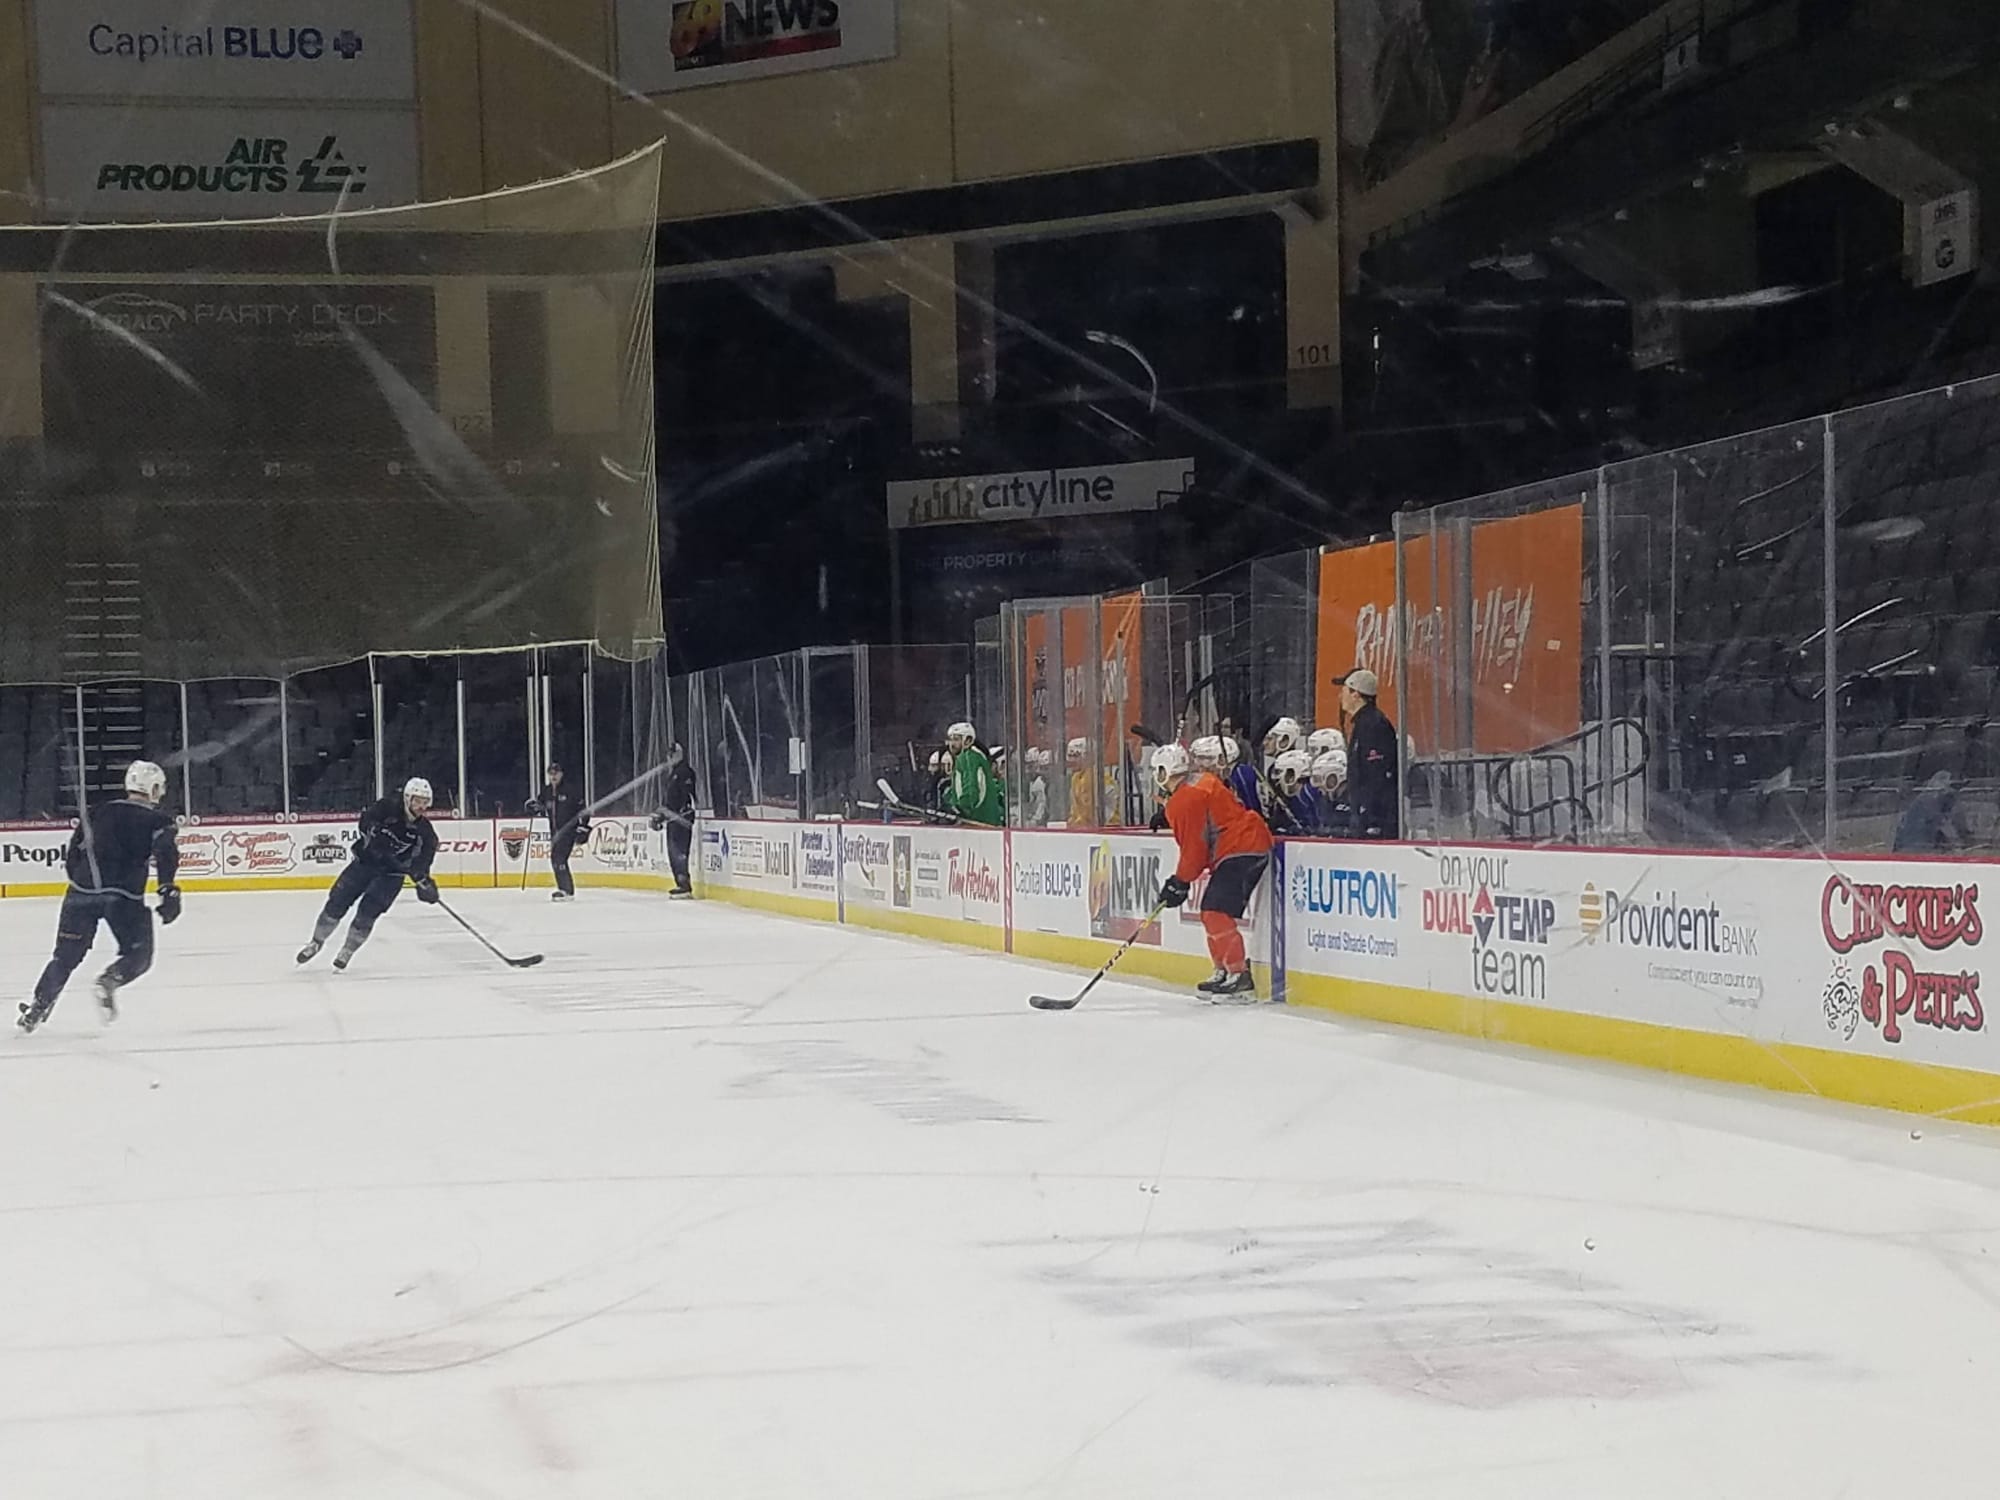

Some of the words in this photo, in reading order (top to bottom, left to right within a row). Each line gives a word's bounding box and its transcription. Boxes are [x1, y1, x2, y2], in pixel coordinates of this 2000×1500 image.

[724, 0, 839, 45] NEWS
[89, 24, 213, 62] Capital
[225, 138, 288, 164] AIR
[97, 164, 288, 192] PRODUCTS
[194, 303, 299, 325] PARTY
[312, 303, 397, 325] DECK
[1297, 344, 1330, 364] 101
[982, 470, 1114, 516] cityline
[943, 552, 1027, 571] PROPERTY
[303, 848, 347, 861] PLAYOFFS
[341, 830, 359, 842] PLA
[438, 840, 489, 853] CCM
[2, 844, 67, 867] Peopl
[1013, 861, 1043, 897] Capital
[1111, 854, 1161, 914] NEWS
[1307, 868, 1397, 920] LUTRON
[1440, 854, 1462, 886] on
[1467, 856, 1508, 898] your
[1422, 889, 1473, 935] DUAL
[1494, 895, 1555, 945] TEMP
[1605, 890, 1720, 953] Provident
[1721, 924, 1758, 956] BANK
[1821, 874, 1983, 954] CHICKIE'S
[1472, 936, 1545, 1000] team
[1860, 965, 1884, 1028] &
[1882, 949, 1984, 1043] PETE'S
